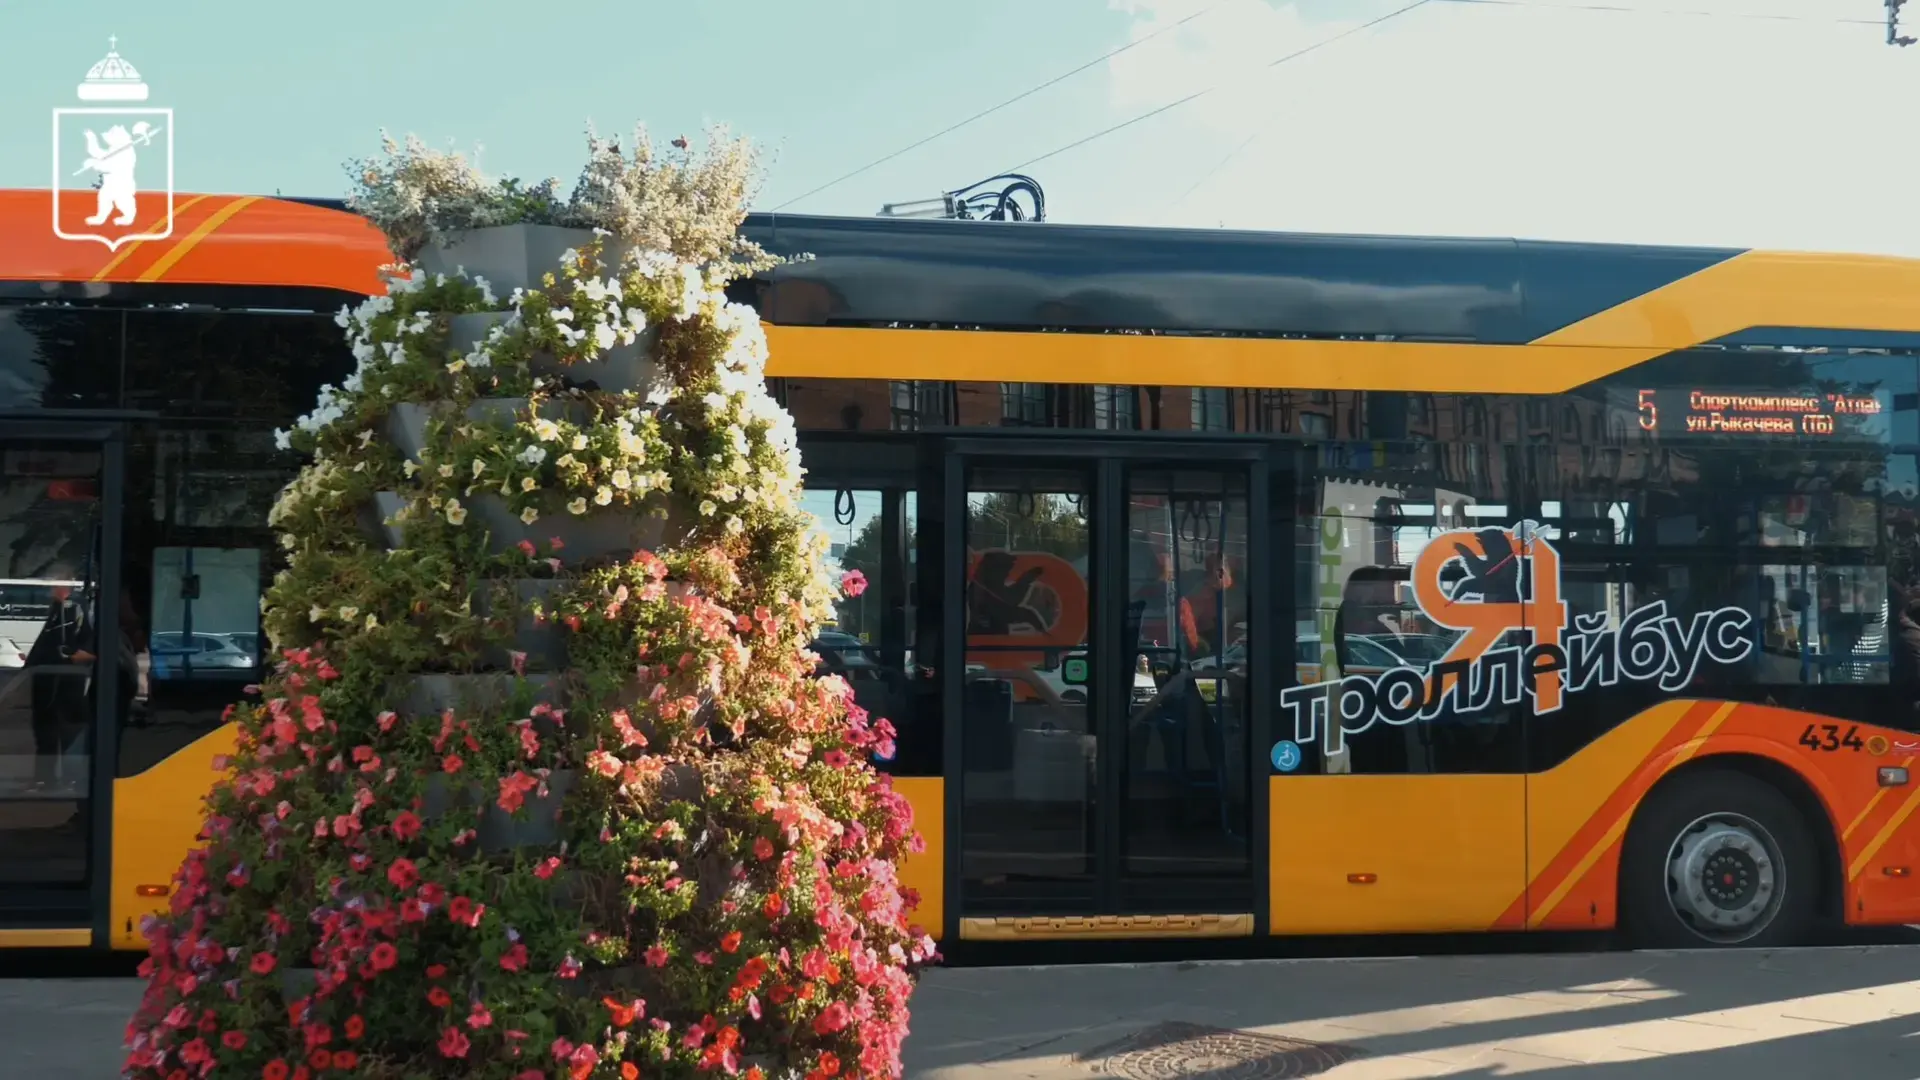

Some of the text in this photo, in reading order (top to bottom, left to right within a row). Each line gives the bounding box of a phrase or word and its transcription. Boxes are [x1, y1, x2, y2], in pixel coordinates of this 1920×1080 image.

[1638, 389, 1657, 432] 5
[1690, 391, 1820, 412] Спорткомплекс
[1802, 414, 1834, 435] (ТБ)
[1280, 600, 1753, 757] троллейбус
[1798, 723, 1865, 752] 434
